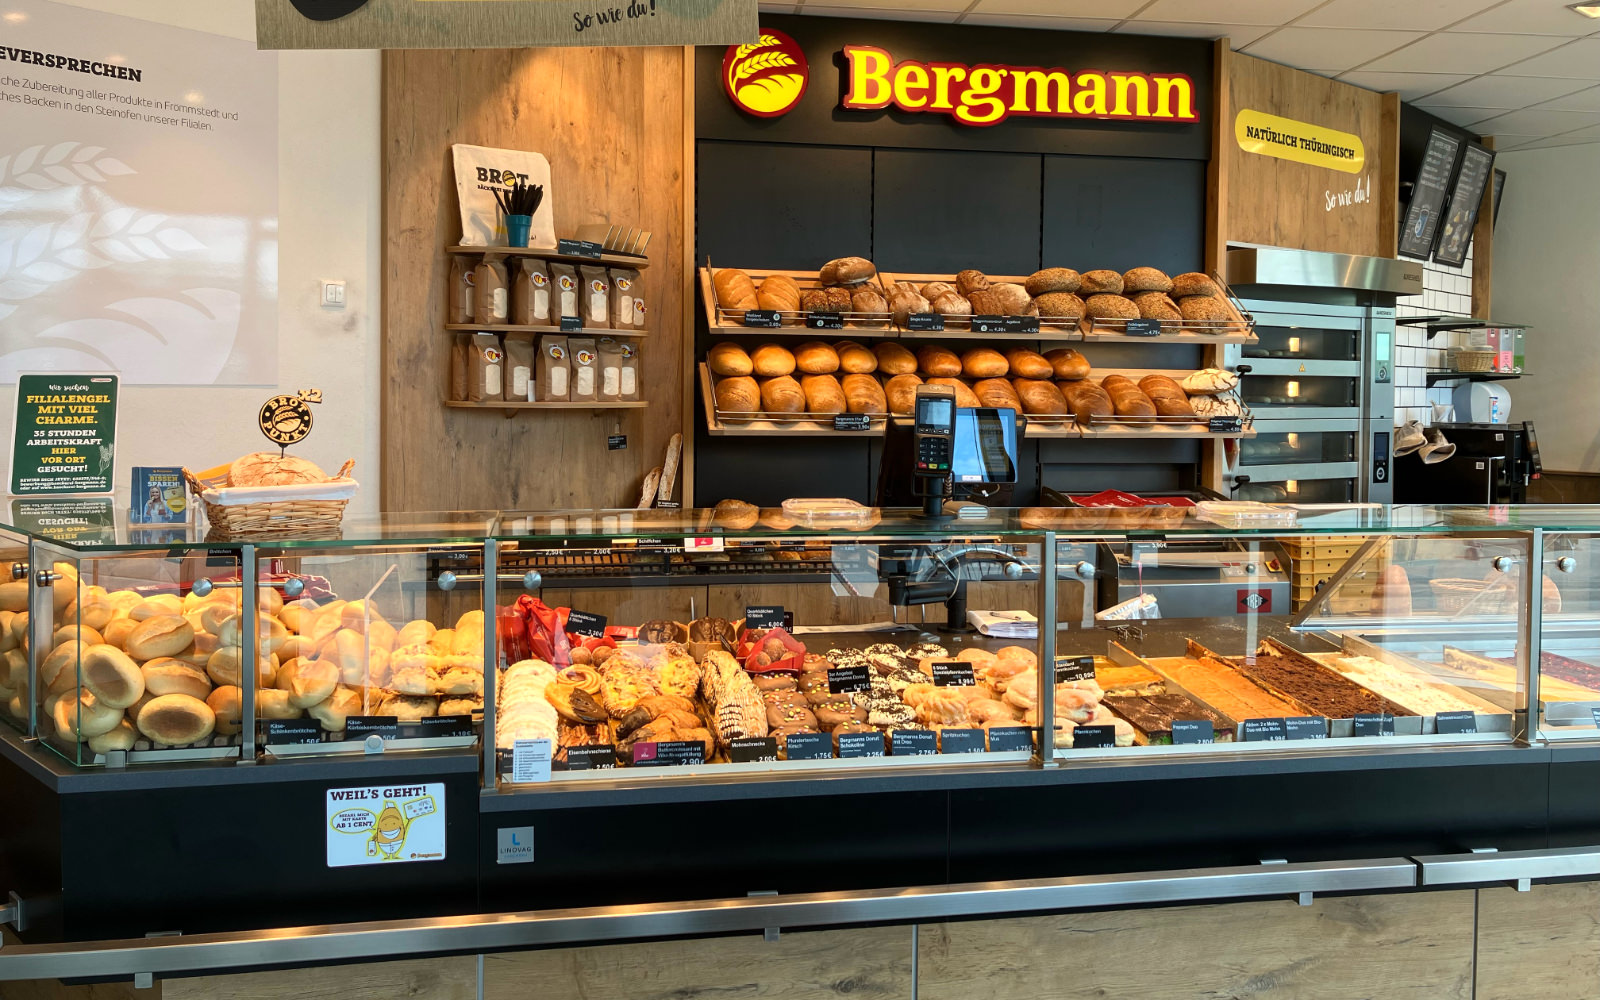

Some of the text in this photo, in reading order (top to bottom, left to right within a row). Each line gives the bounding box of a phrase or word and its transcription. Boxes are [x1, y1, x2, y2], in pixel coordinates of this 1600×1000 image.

[574, 12, 594, 32] So
[596, 8, 624, 24] wie
[849, 49, 1195, 122] Bergmann
[22, 78, 84, 99] Zubereitung
[86, 89, 107, 101] aller
[109, 92, 152, 108] Produkte
[155, 101, 163, 109] in
[222, 111, 238, 121] und
[24, 94, 61, 109] Backen
[63, 102, 72, 110] in
[75, 102, 94, 114] den
[144, 114, 179, 126] unserer
[1246, 125, 1355, 160] NATÜRLICH THÜRINGISCH
[1325, 174, 1370, 211] So wie du!
[26, 395, 111, 403] FILIALENGEL
[269, 397, 307, 412] BROT
[38, 405, 98, 414] MIT VIEL
[36, 416, 98, 425] CHARME.
[263, 421, 308, 441] PUNKT
[65, 456, 86, 464] ORT
[37, 465, 88, 473] GESUCHT!
[330, 786, 427, 801] WEIL'S GEHT!
[500, 846, 532, 854] LINOVAG
